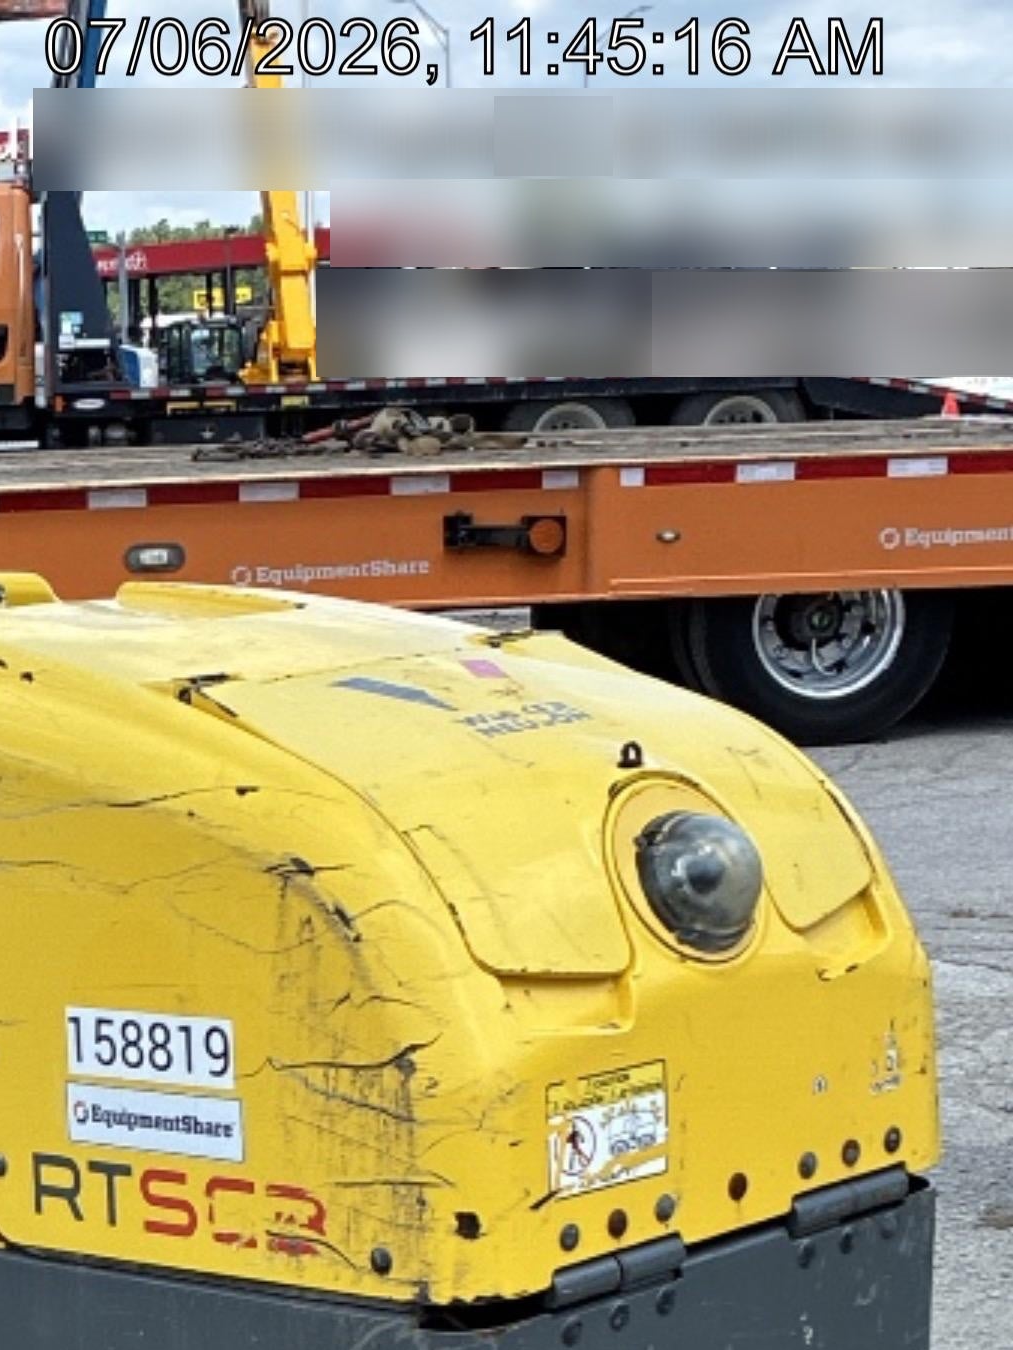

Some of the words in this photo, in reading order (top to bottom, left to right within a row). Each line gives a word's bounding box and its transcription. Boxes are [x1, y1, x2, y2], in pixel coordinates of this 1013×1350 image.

[255, 559, 430, 585] EquipmentShare
[67, 1016, 231, 1079] 158819
[91, 1103, 235, 1138] EquipmentShare
